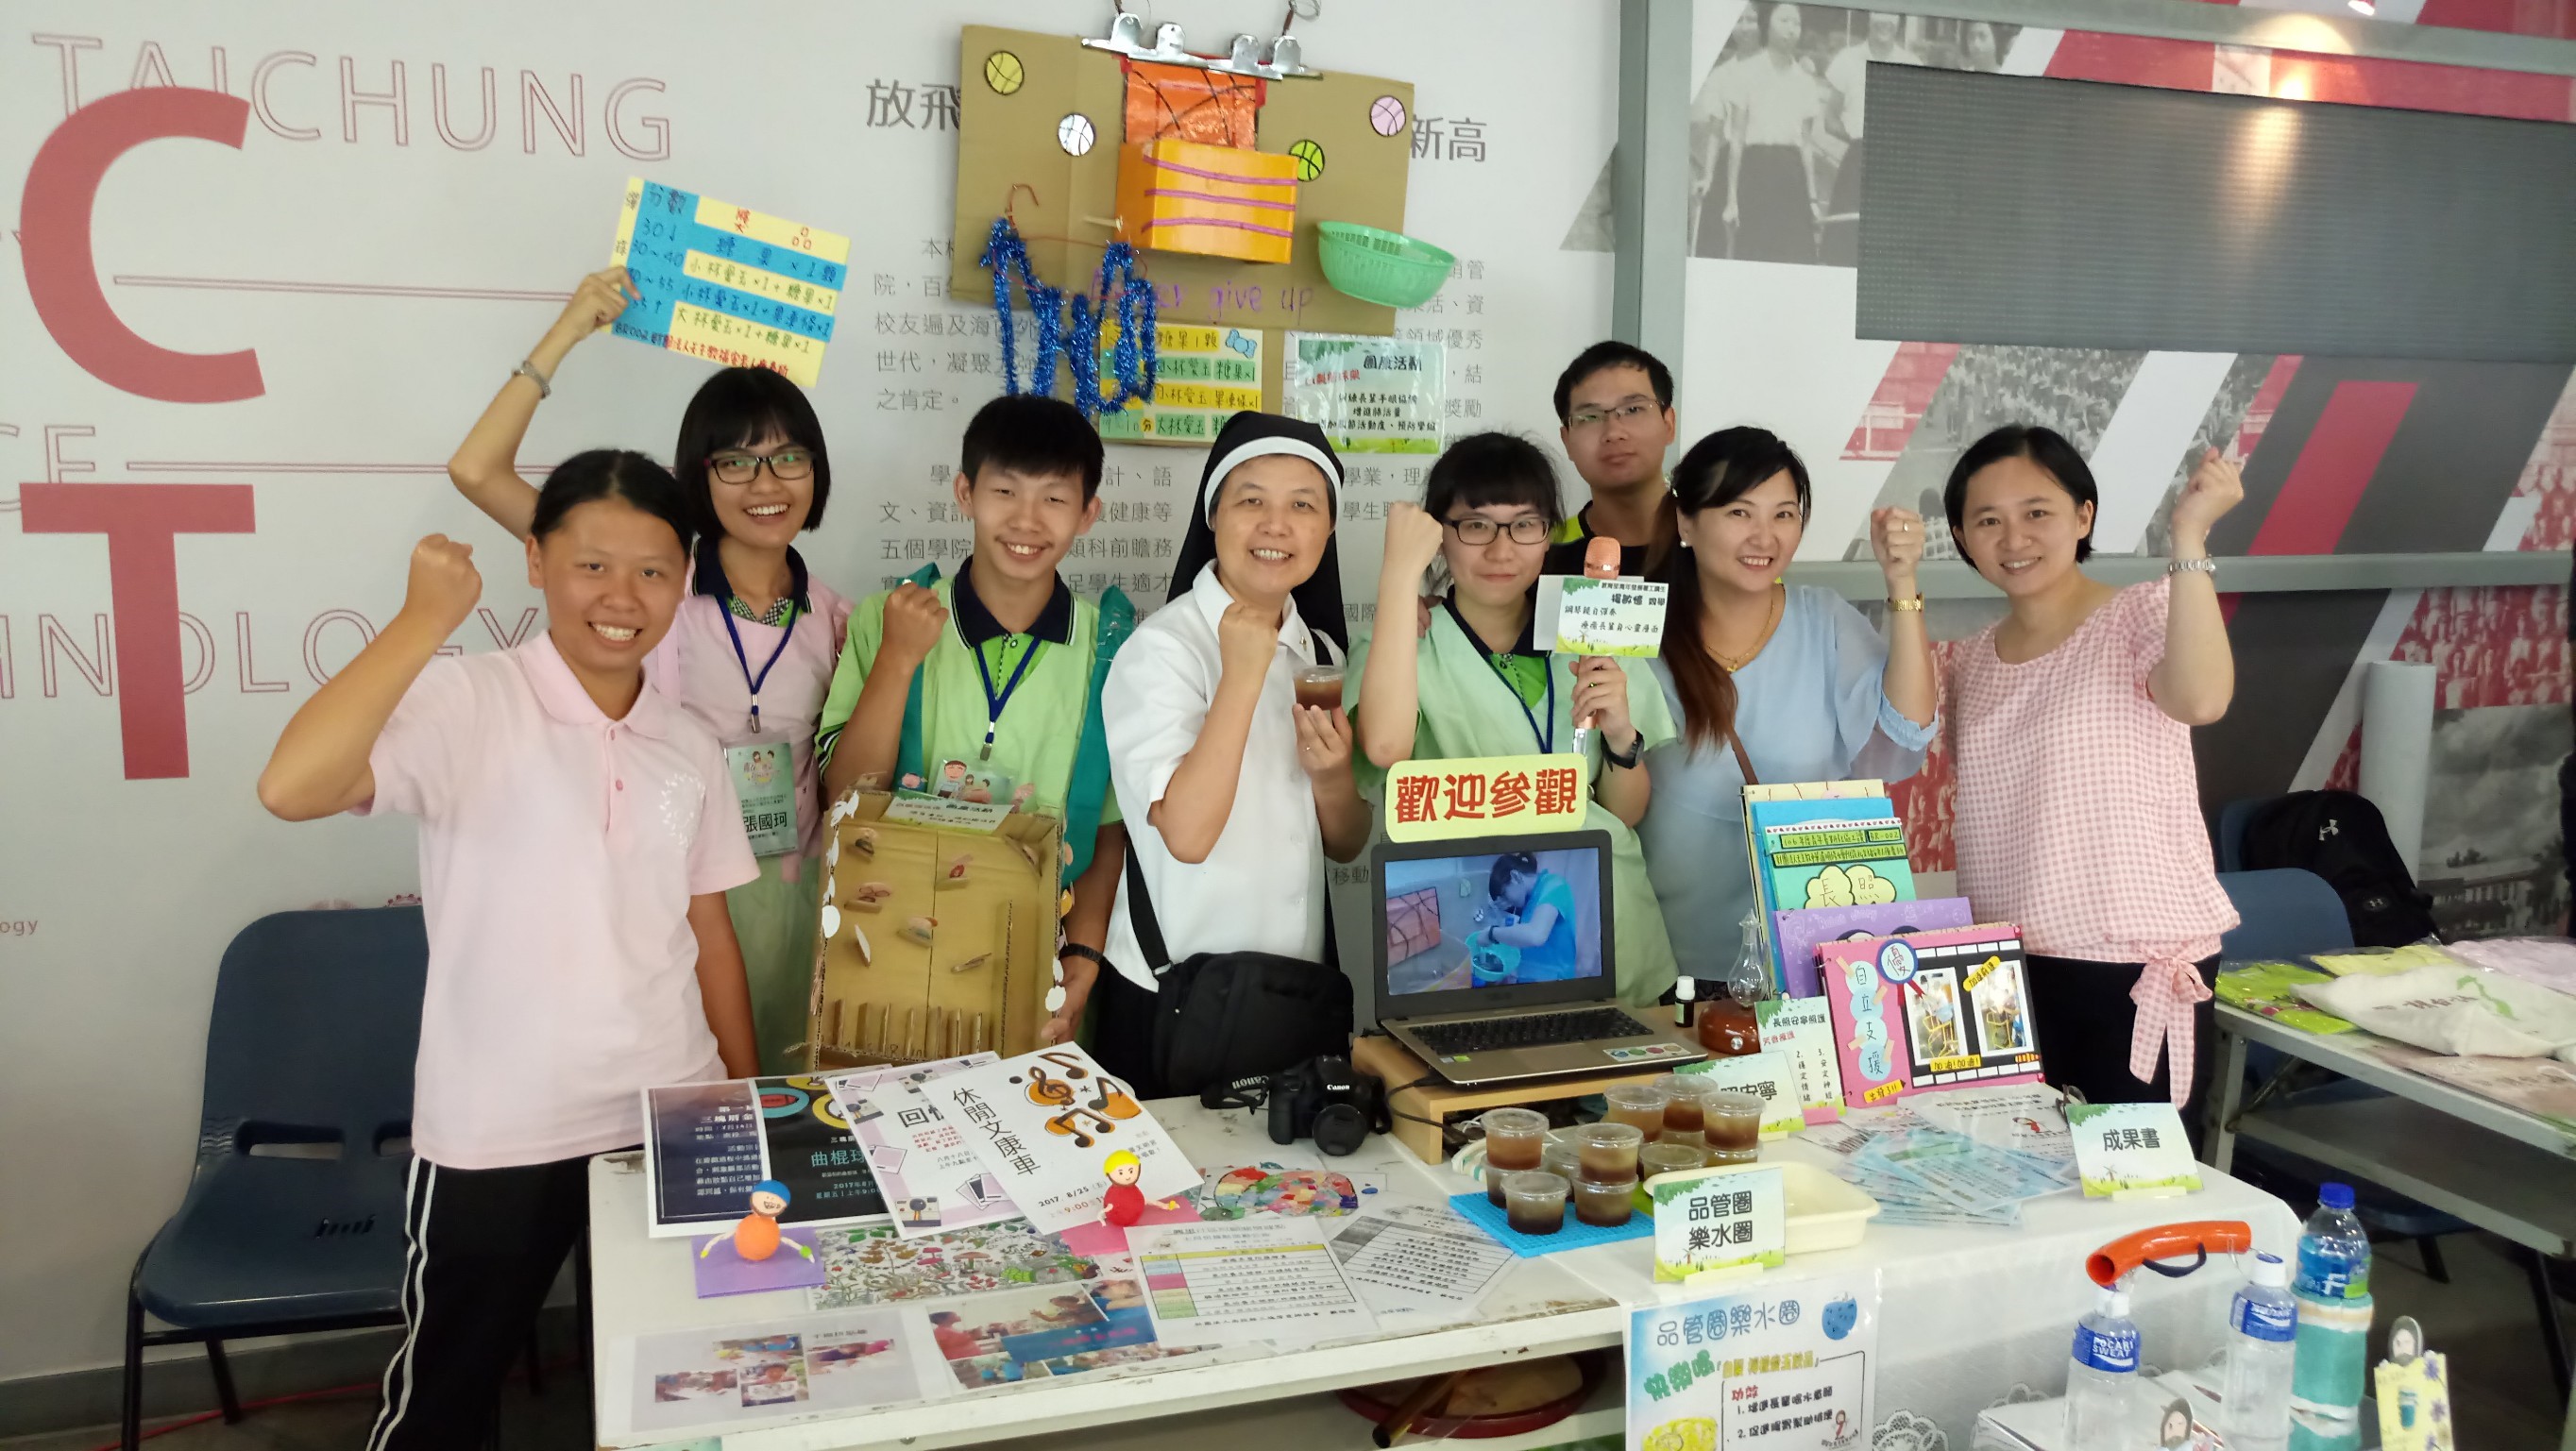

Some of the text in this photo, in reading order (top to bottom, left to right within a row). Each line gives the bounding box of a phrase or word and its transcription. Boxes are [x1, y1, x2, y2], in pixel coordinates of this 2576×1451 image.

[20, 86, 265, 404] C
[1209, 281, 1263, 326] give
[1280, 286, 1314, 327] up
[875, 350, 1034, 374] 世代，凝聚強
[1343, 466, 1430, 487] 學業，理
[19, 482, 256, 780] T
[1395, 768, 1577, 823] 歡迎參觀
[2103, 1127, 2161, 1153] 成果書
[1066, 1186, 1090, 1199] 8/25
[1688, 1189, 1754, 1222] 品管圈
[1688, 1219, 1754, 1251] 樂水圈
[1656, 1299, 1800, 1347] 品管圈樂水圈
[2093, 1335, 2133, 1351] POCARI
[2093, 1343, 2130, 1358] SWEAT
